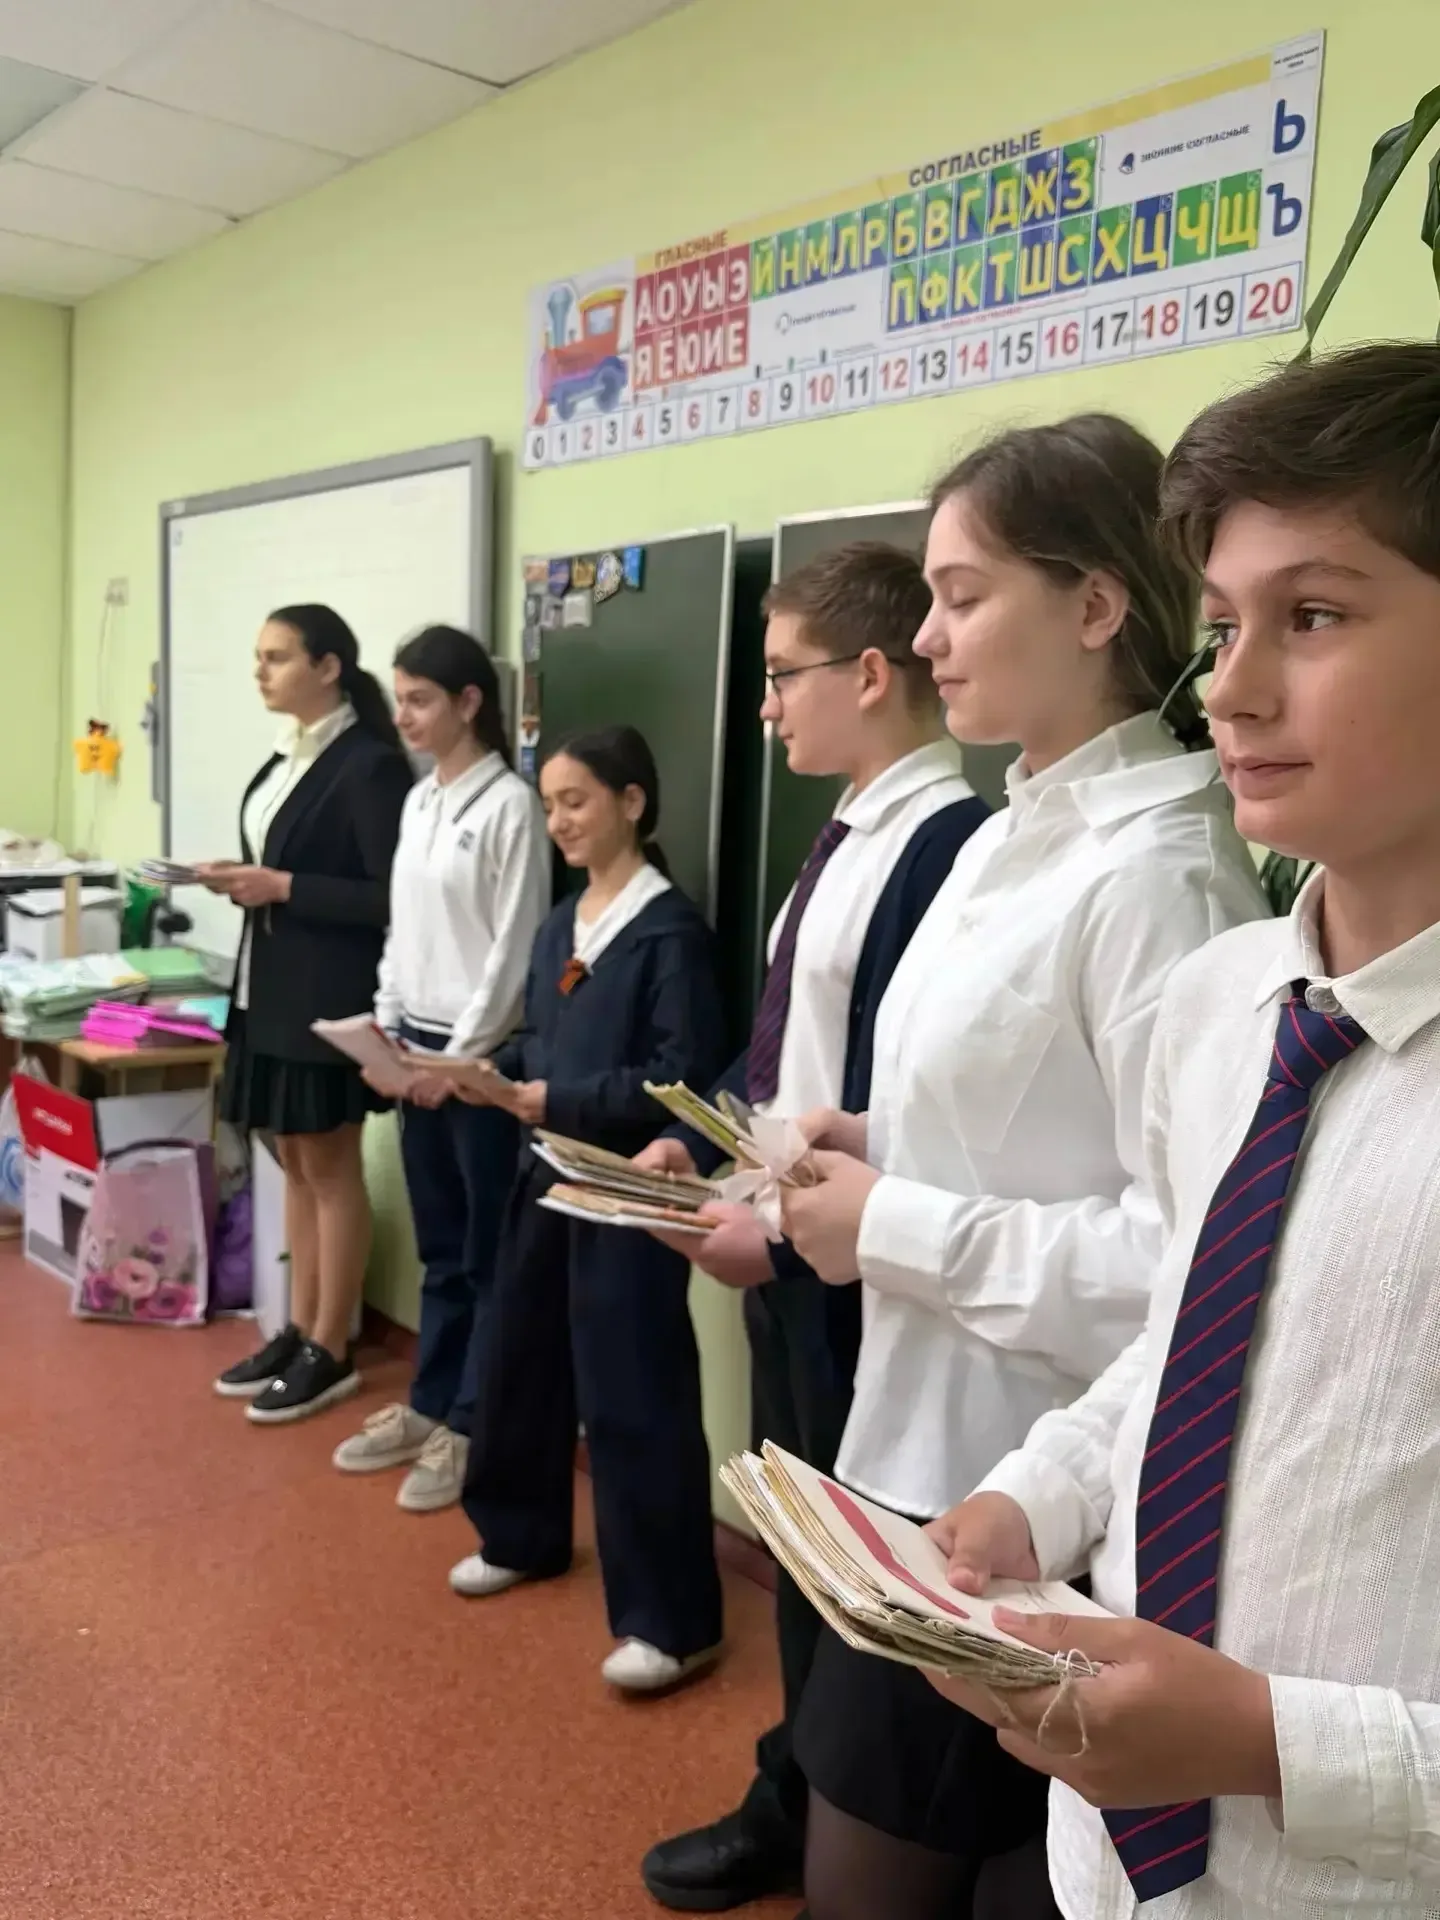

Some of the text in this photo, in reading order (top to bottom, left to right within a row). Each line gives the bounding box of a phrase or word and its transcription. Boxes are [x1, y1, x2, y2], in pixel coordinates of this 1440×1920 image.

[909, 130, 1042, 188] СОГЛАСНЫЕ
[1266, 182, 1302, 237] Ъ
[655, 229, 728, 267] ГЛАСНЫЕ
[532, 277, 1293, 460] 0 1 2 3 4 5 6 7 8 9 10 11 12 13 14 15 16 17 18 19 20
